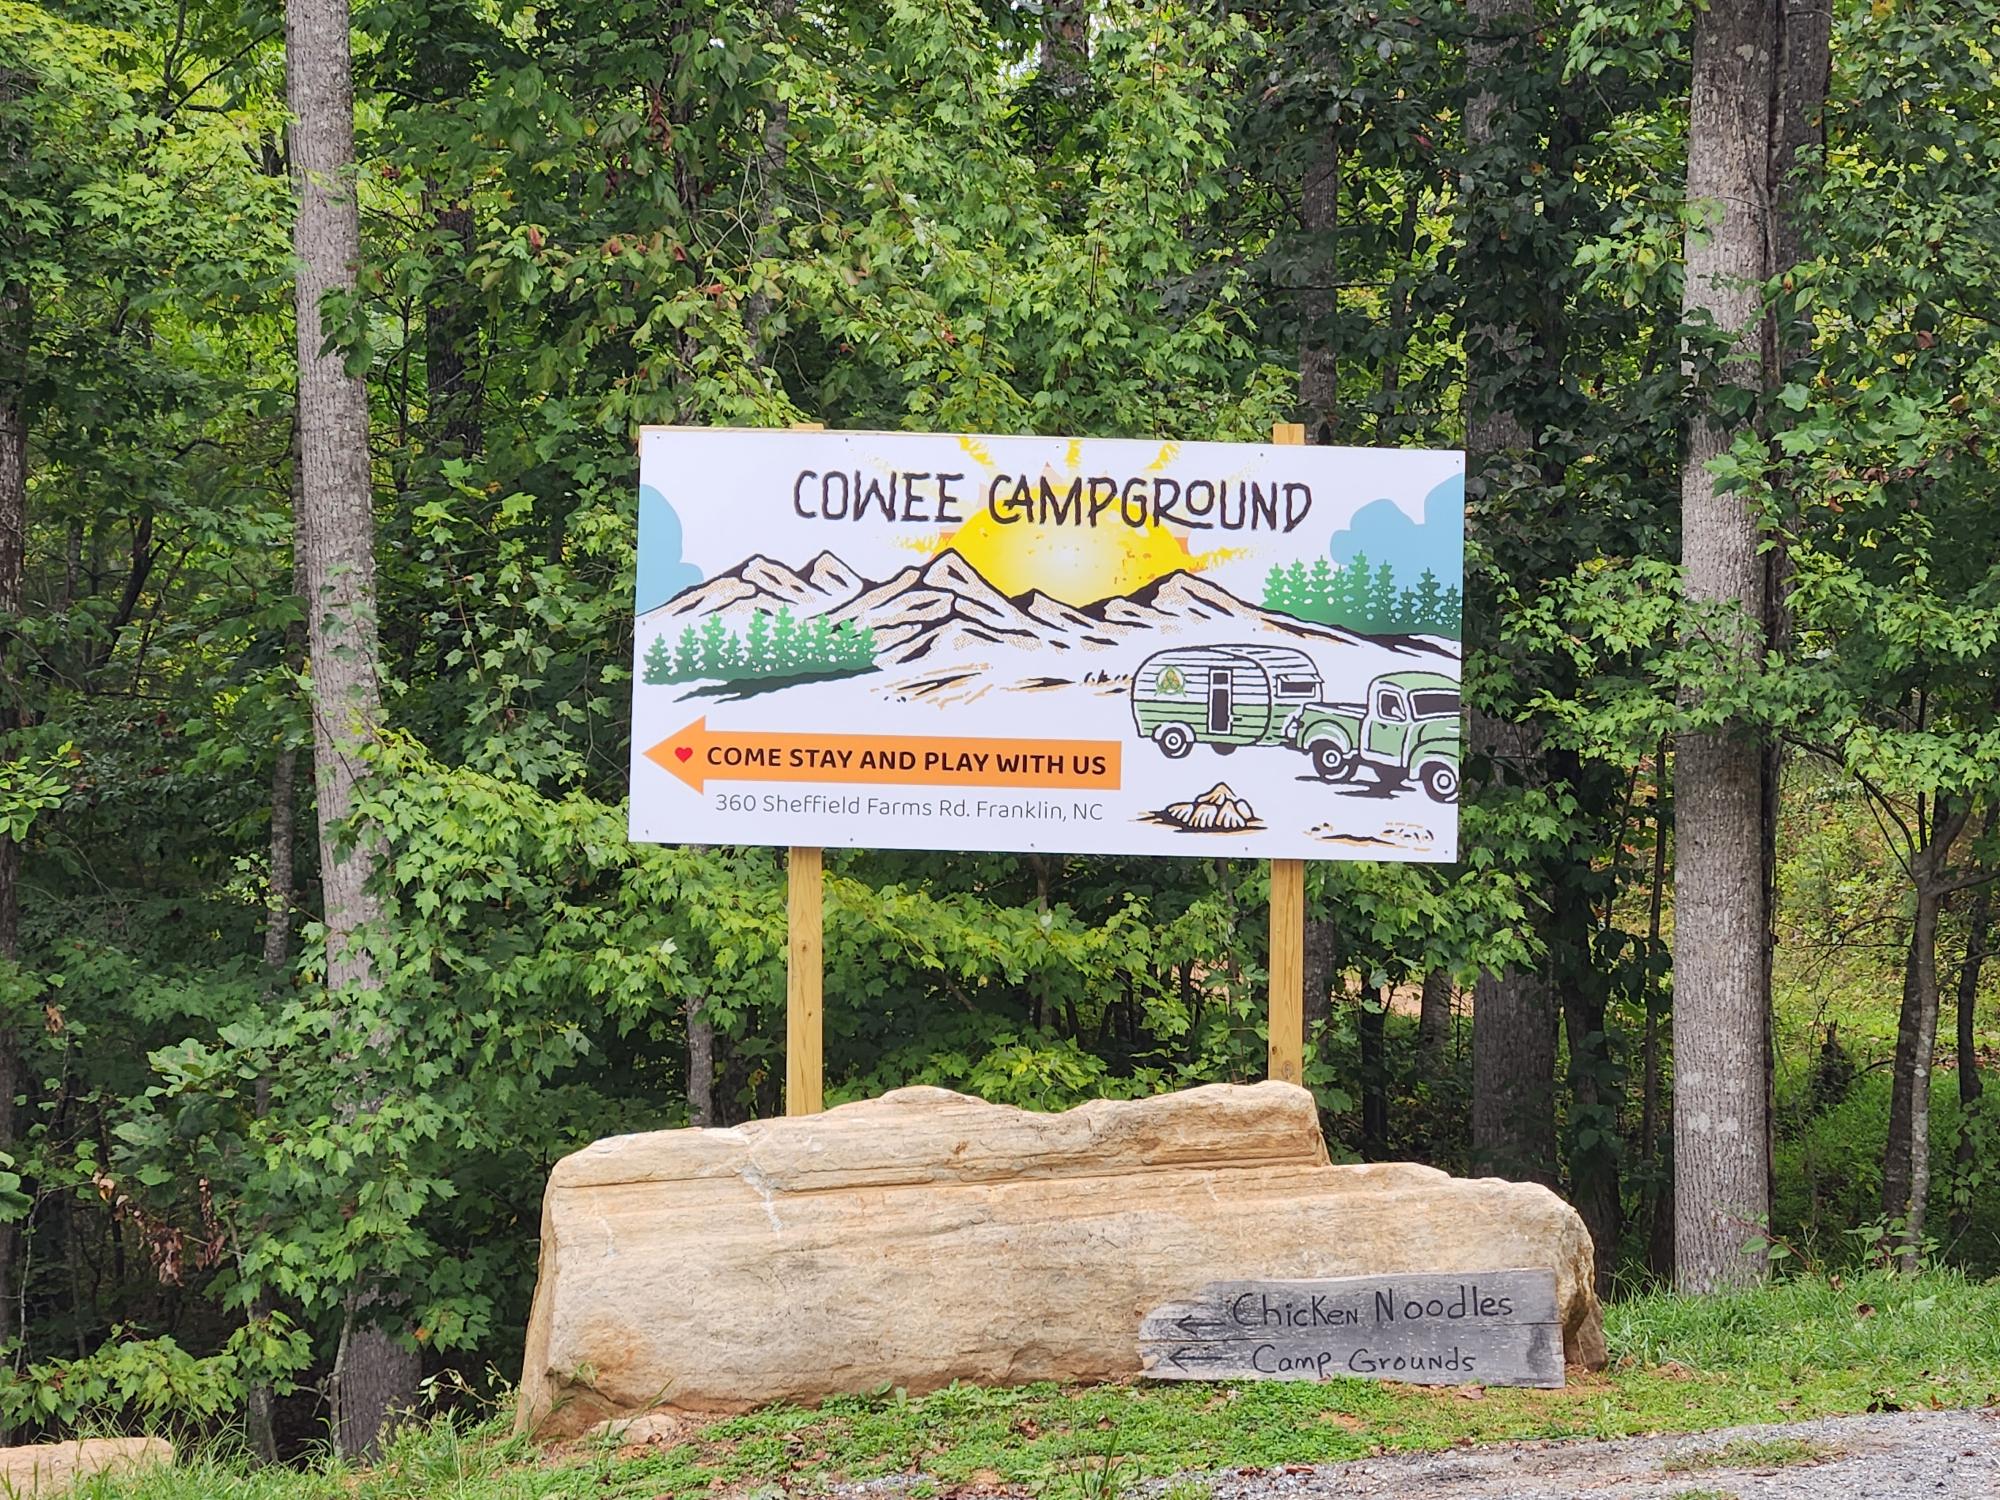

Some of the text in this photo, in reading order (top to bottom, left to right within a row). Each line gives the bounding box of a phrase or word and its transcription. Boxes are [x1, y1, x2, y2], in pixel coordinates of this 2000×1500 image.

[793, 470, 1313, 533] COWEE CAMPGROUND
[706, 746, 1107, 776] COME STAY AND PLAY WITH US
[715, 793, 1104, 822] 360 Sheffield Farms Rd. Franklin, NC
[1375, 1284, 1513, 1324] Noodles
[1252, 1344, 1331, 1378] Camp
